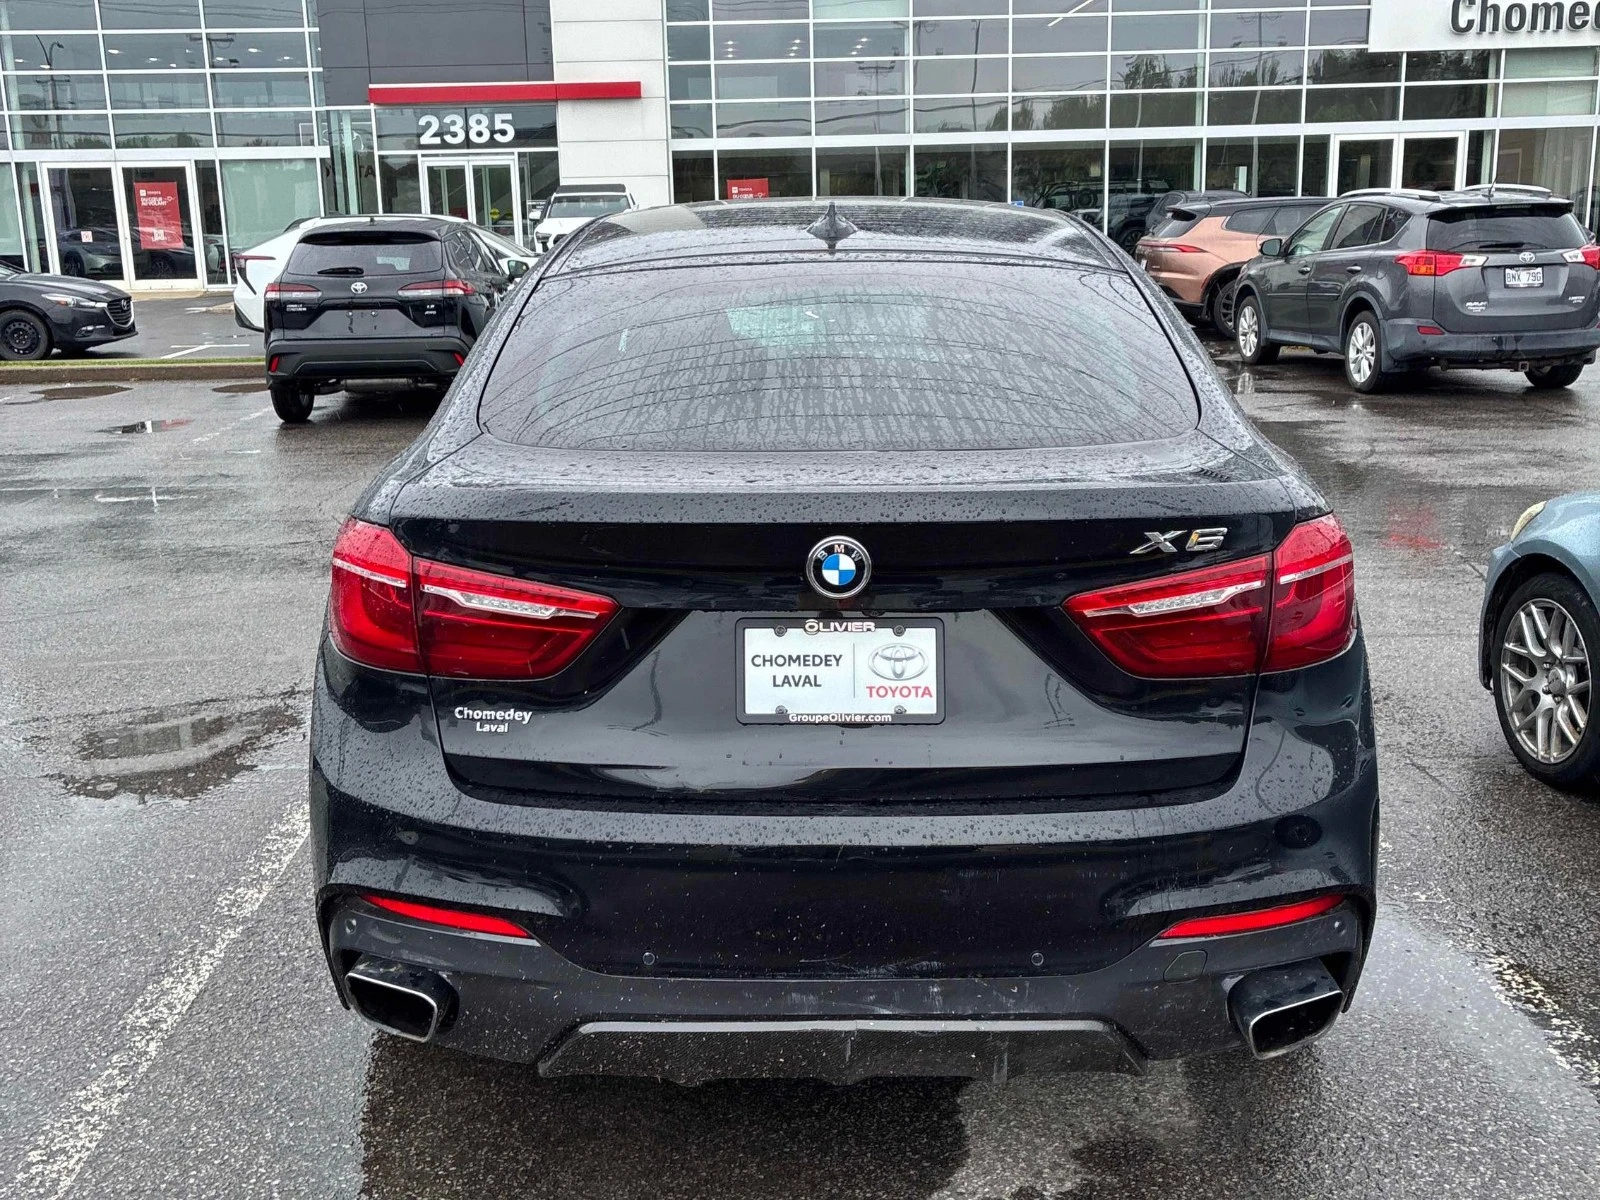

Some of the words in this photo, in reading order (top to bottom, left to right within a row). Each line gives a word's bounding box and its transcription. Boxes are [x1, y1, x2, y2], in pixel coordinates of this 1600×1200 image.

[1450, 0, 1600, 33] Chome
[418, 113, 515, 145] 2385
[1129, 527, 1228, 554] X6
[817, 544, 861, 561] BMW
[751, 654, 843, 668] CHOMEDEY
[772, 674, 822, 688] LAVAL
[866, 685, 933, 699] TOYOTA
[454, 706, 533, 725] Chomedey
[788, 712, 892, 724] GroupeOlivier.com
[475, 721, 509, 733] Laval
